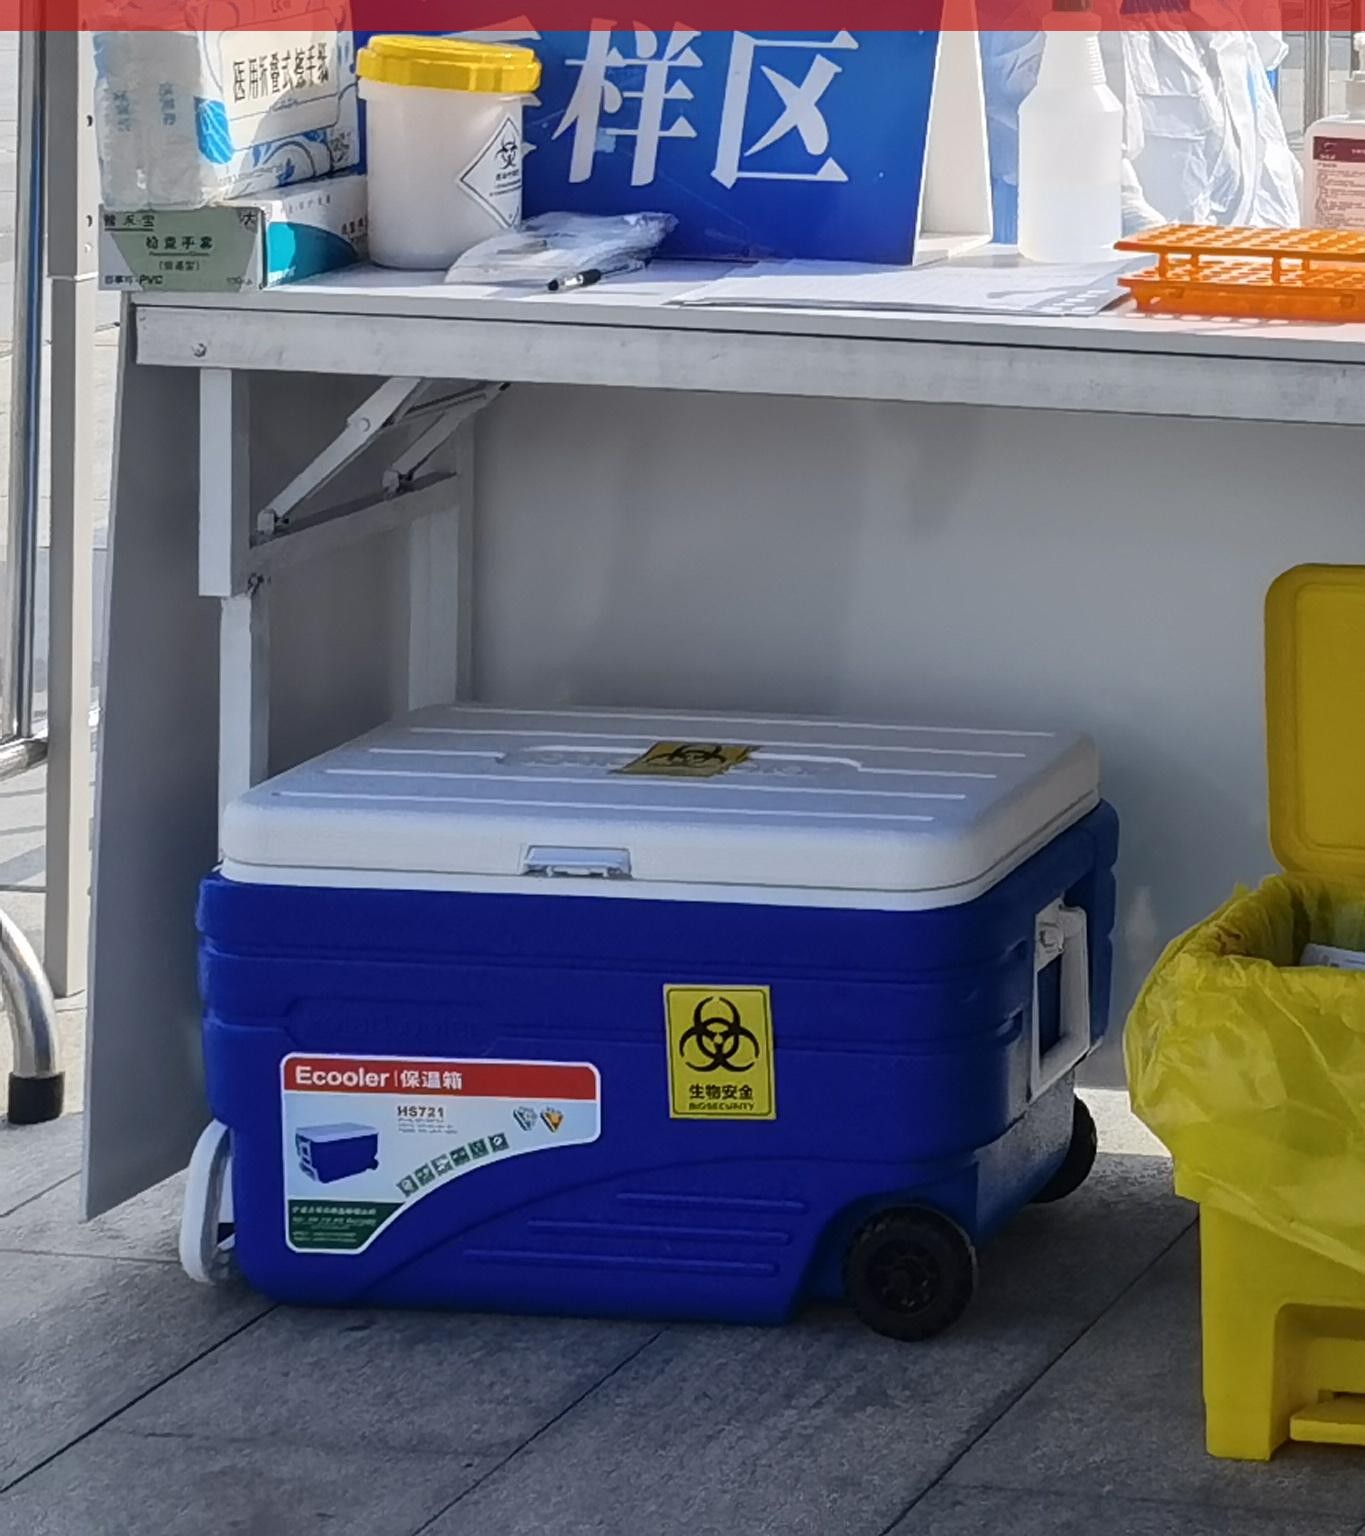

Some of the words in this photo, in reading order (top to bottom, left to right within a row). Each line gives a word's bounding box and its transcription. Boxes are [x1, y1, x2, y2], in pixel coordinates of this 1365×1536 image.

[295, 1065, 389, 1088] Ecooler
[400, 1070, 463, 1090] 保温箱
[689, 1084, 754, 1100] 生物安全
[397, 1105, 444, 1118] HS721
